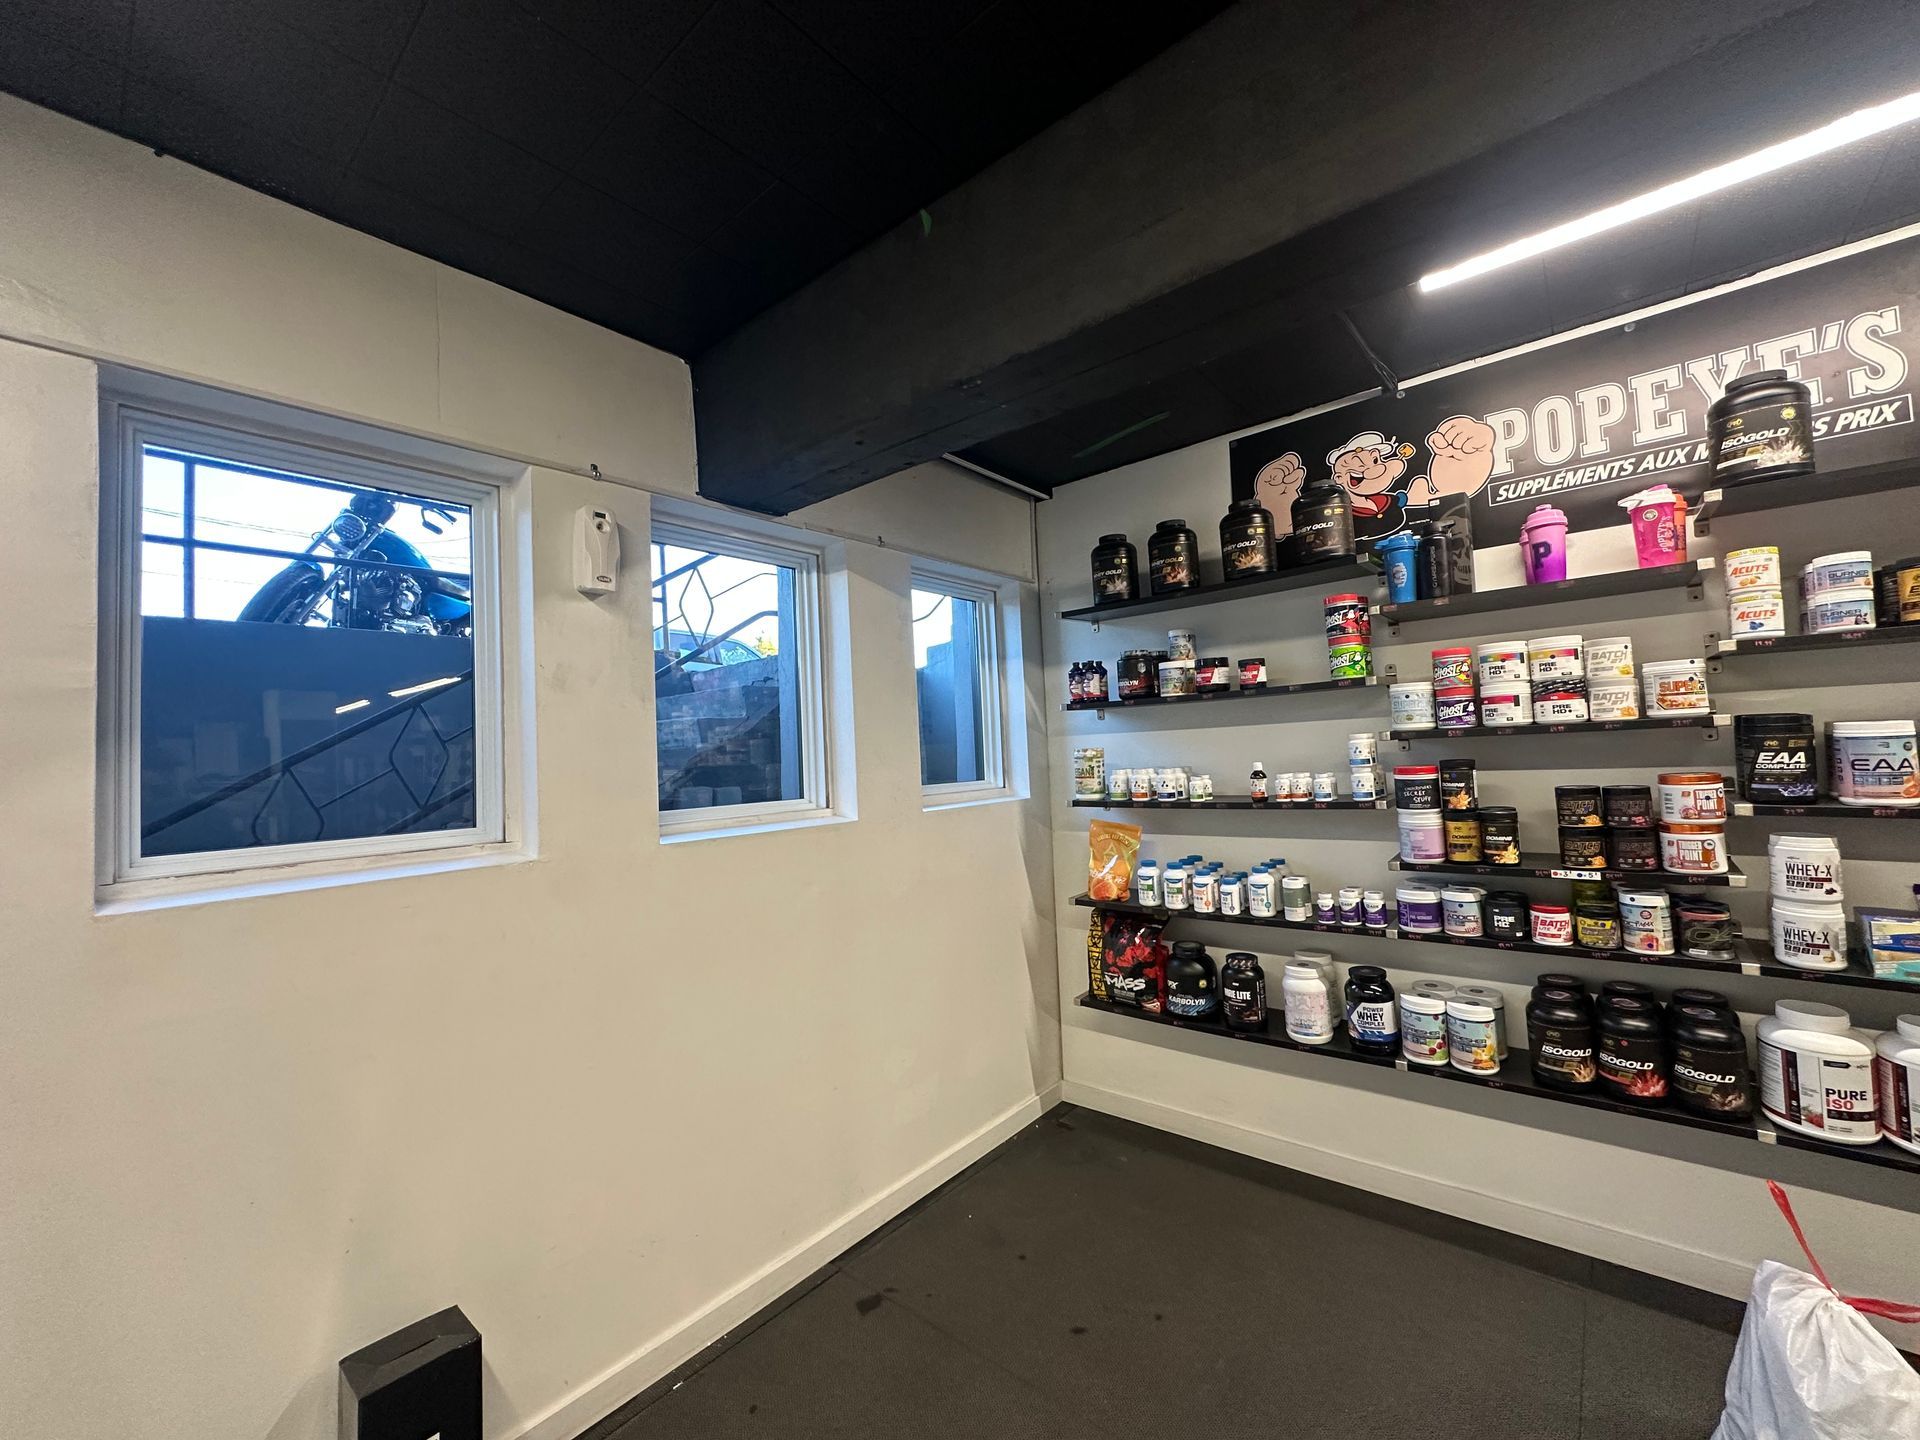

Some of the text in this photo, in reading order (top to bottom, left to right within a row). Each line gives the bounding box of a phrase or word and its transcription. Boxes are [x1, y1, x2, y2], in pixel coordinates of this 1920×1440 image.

[1484, 304, 1909, 476] POPEYE'S
[1721, 427, 1791, 450] ISOGOLD
[1496, 401, 1903, 501] SUPPLÉMENTS AUX PRIX
[1532, 541, 1552, 569] P
[1730, 564, 1769, 577] ACUTS
[1736, 609, 1776, 621] ACUTS
[1591, 651, 1627, 661] BATCH
[1434, 662, 1462, 681] GHOST
[1593, 692, 1629, 703] BATCH
[1439, 702, 1468, 721] GHOST
[1757, 752, 1806, 763] EAA
[1851, 758, 1914, 771] EAA
[1697, 799, 1717, 810] POINT
[1680, 850, 1702, 861] POINT
[1785, 862, 1832, 877] WHEY-X
[1540, 919, 1570, 929] BATCH
[1783, 926, 1829, 943] WHEY-X
[1104, 975, 1146, 991] MASS
[1168, 995, 1206, 1006] KARBOLYN
[1356, 1011, 1384, 1022] WHEY
[1356, 1019, 1386, 1027] COMPLEX
[1542, 1044, 1592, 1057] ISOGOLD
[1600, 1051, 1654, 1070] ISOGOLD
[1674, 1063, 1736, 1084] ISOGOLD
[1825, 1087, 1868, 1101] PURE
[1826, 1098, 1855, 1111] ISO
